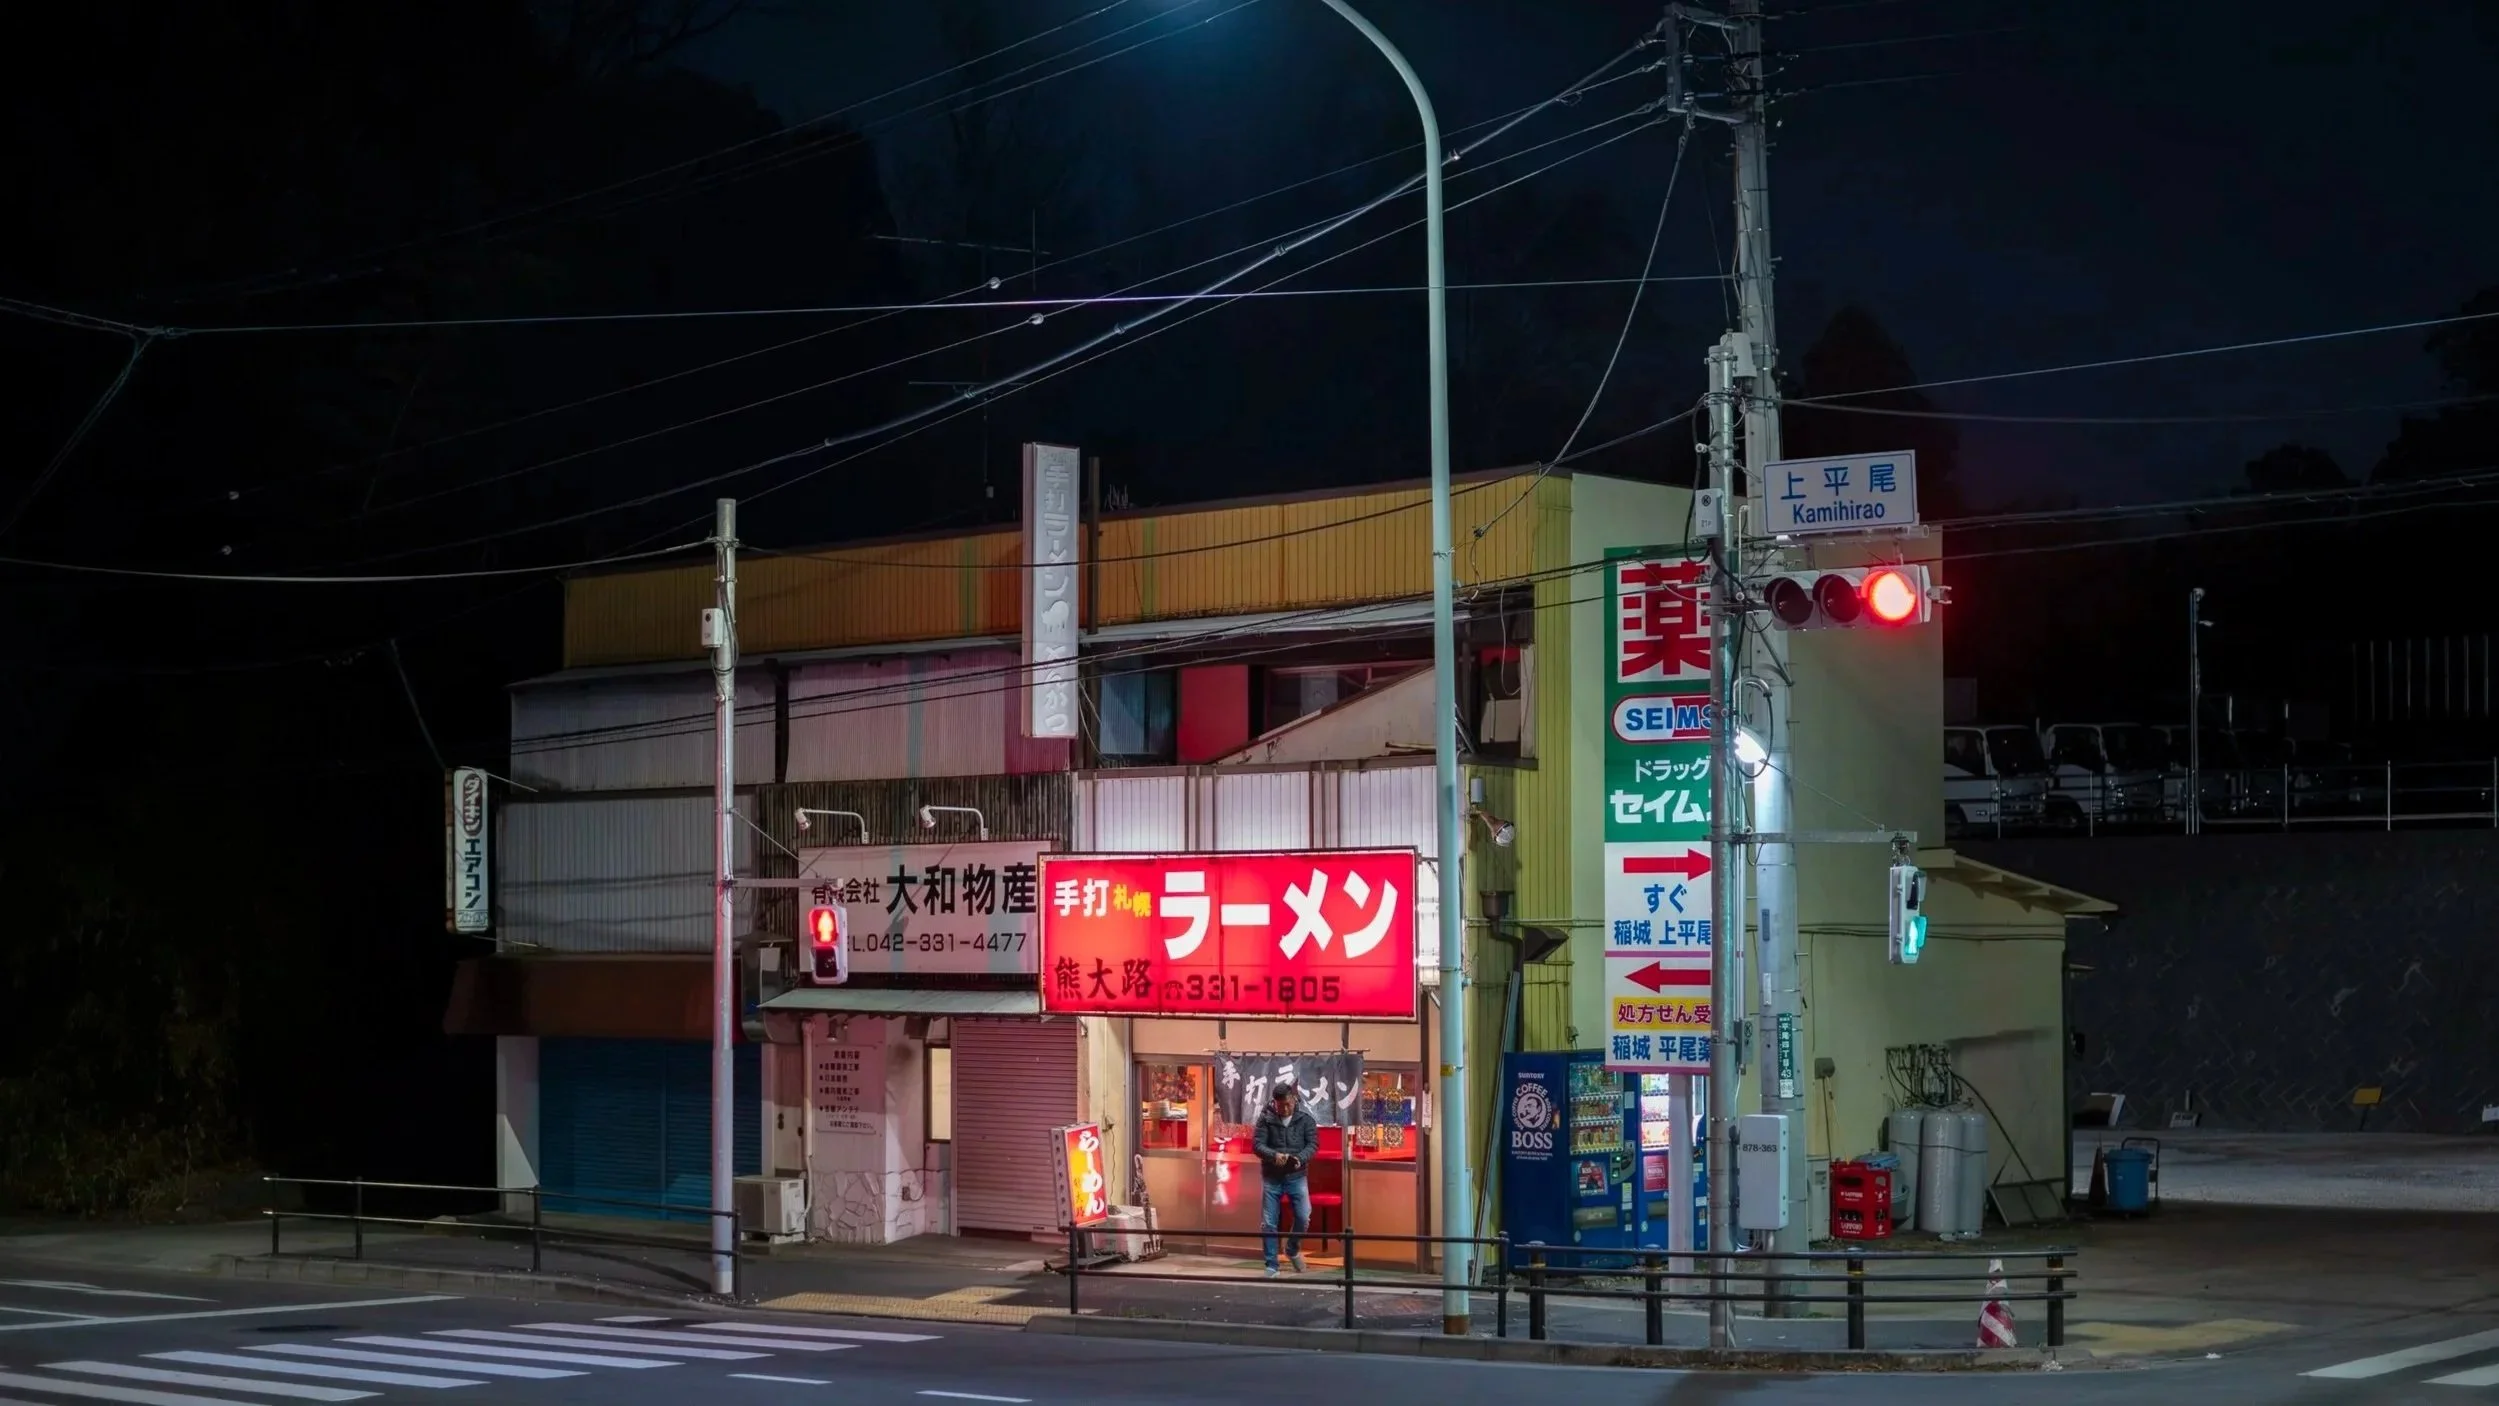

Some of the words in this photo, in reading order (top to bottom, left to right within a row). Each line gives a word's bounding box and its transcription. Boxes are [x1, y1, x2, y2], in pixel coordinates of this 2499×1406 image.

[1780, 463, 1896, 500] 上平尾
[1793, 501, 1885, 524] Kamihirao
[1621, 560, 1711, 677] 薬
[1635, 756, 1711, 783] ドラッグ
[465, 776, 481, 831] ダイキン
[1610, 789, 1711, 824] セイム
[465, 838, 482, 909] エアコン
[886, 862, 1036, 916] 大和物産
[1054, 878, 1109, 917] 手打
[1114, 885, 1151, 917] 札幌
[1160, 868, 1398, 960] ラーメン
[1644, 883, 1687, 914] すぐ
[848, 932, 1026, 952] L.042-331-4477
[1614, 920, 1651, 946] 稲城
[1054, 956, 1151, 1000] 熊大路
[1187, 975, 1340, 1002] 331-1805
[1618, 1004, 1711, 1024] 処方せん受
[1613, 1035, 1650, 1061] 稲城
[1515, 1083, 1548, 1098] COFFEE
[1511, 1131, 1552, 1149] BOSS
[1079, 1130, 1105, 1217] らーめん
